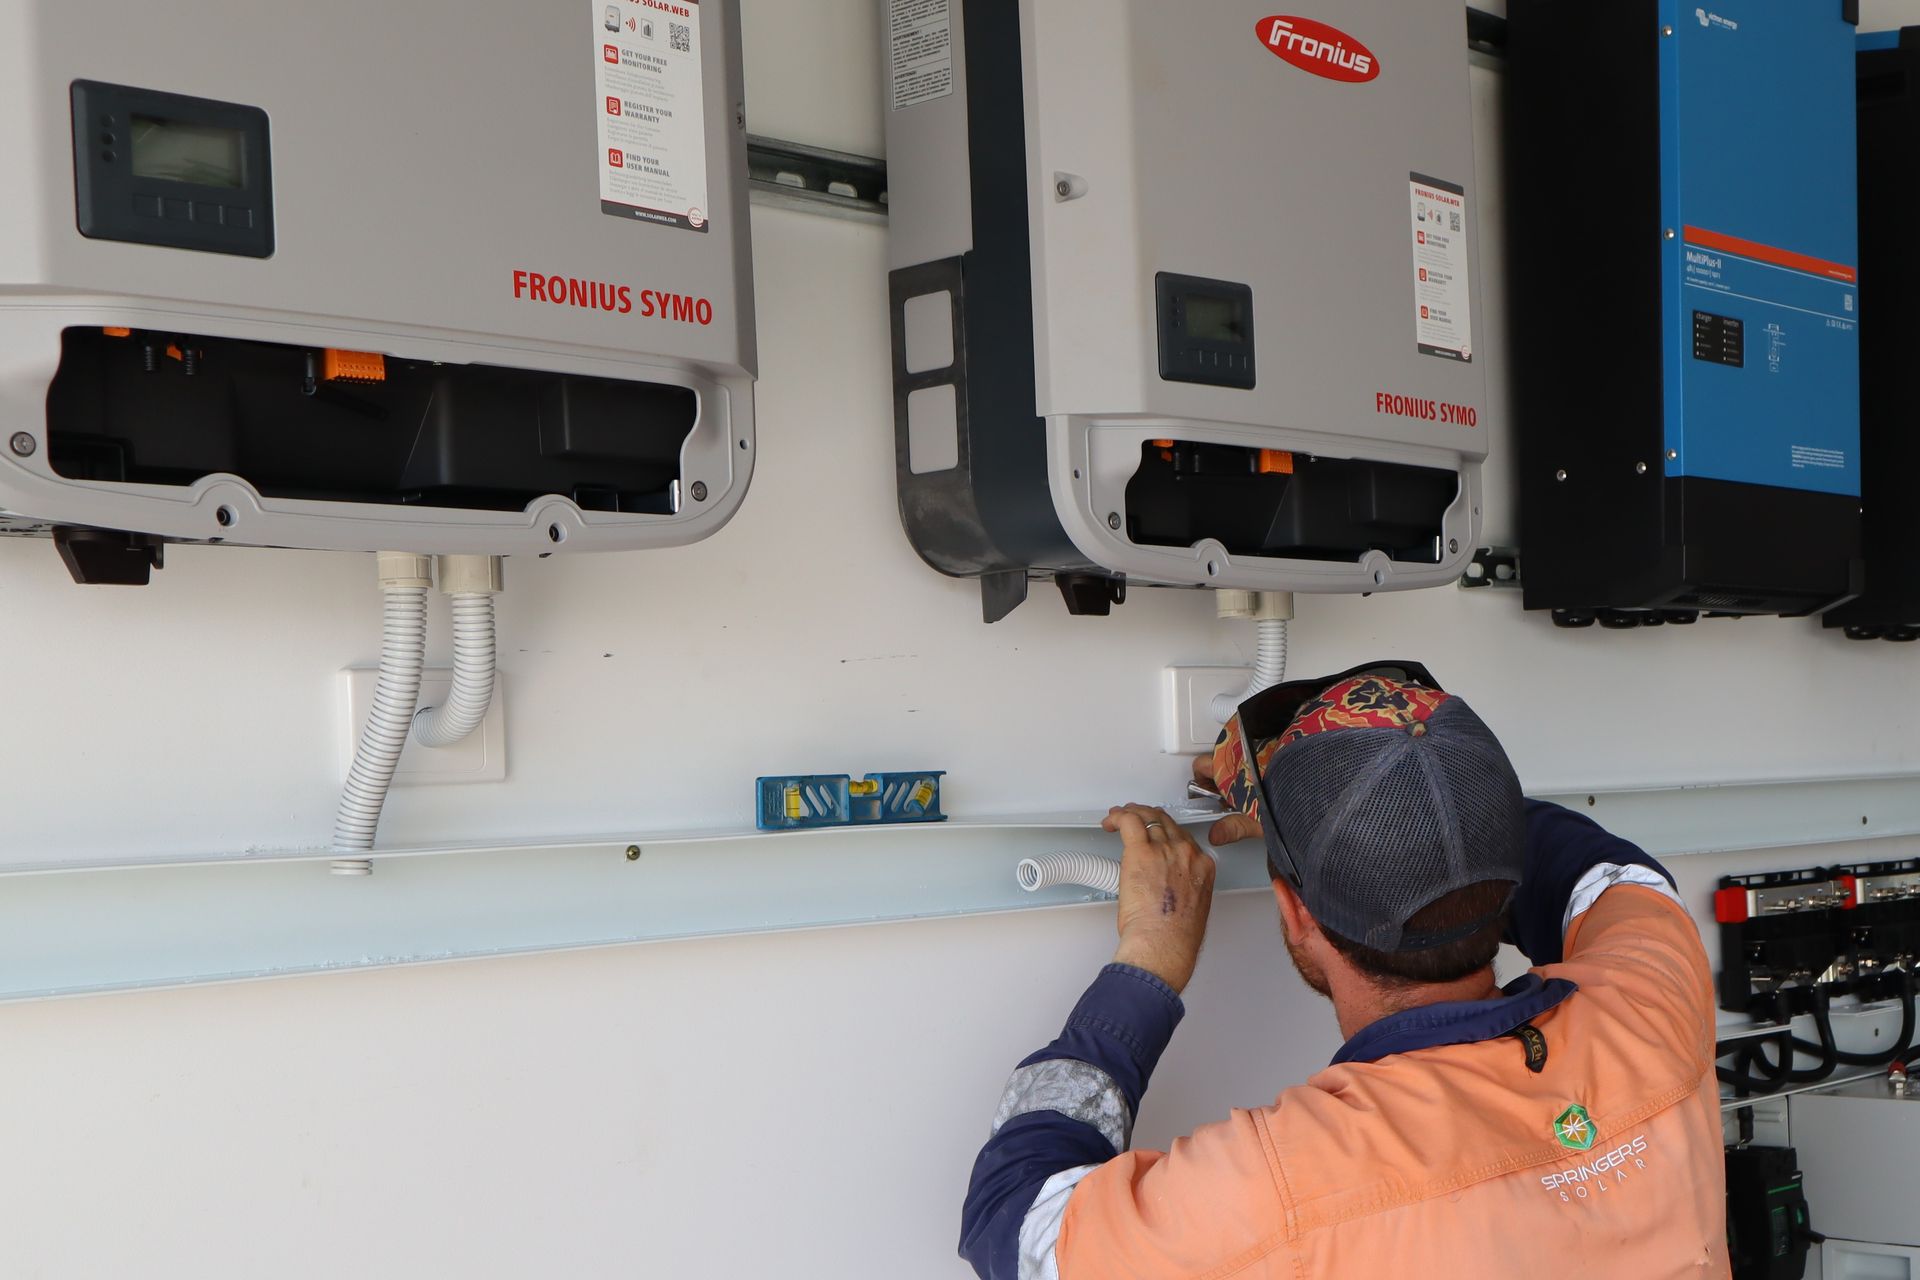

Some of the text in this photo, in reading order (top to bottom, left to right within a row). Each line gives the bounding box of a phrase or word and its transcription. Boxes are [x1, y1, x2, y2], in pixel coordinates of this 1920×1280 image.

[642, 0, 690, 17] SOLAR.WEB
[1268, 19, 1371, 74] Fronius
[621, 49, 668, 66] GET YOUR FREE
[622, 58, 663, 74] MONITORING
[624, 101, 673, 118] REGISTER YOUR
[624, 110, 660, 123] WARRANTY
[626, 153, 660, 166] FIND YOUR
[626, 162, 671, 177] USER MANUAL
[512, 269, 713, 326] FRONIUS SYMO
[1376, 392, 1477, 427] FRONIUS SYMO
[1541, 1135, 1648, 1191] SPRINGERS
[1559, 1160, 1647, 1202] SOLAR
